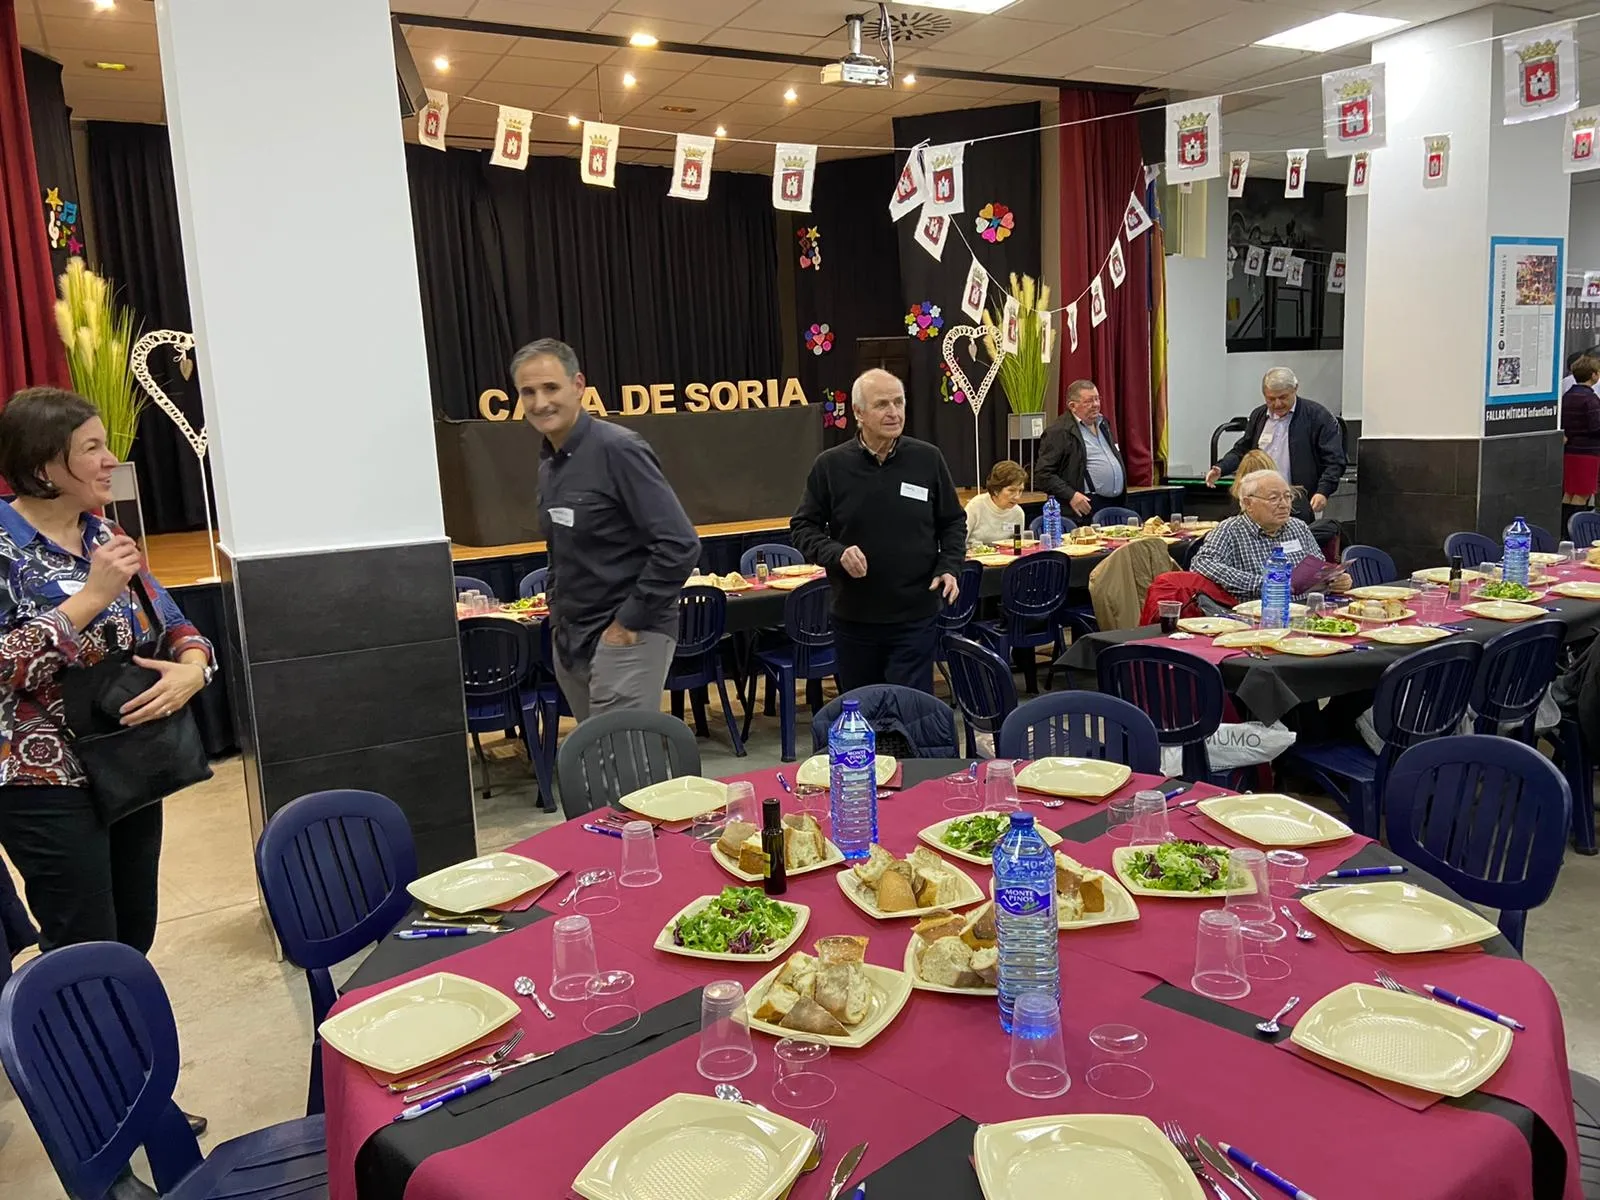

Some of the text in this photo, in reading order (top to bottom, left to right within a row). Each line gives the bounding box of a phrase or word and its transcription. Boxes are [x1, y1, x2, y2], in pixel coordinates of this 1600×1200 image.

[479, 377, 809, 421] CA DE SORIA
[1486, 409, 1506, 421] FALLAS
[1005, 889, 1034, 897] MONTE
